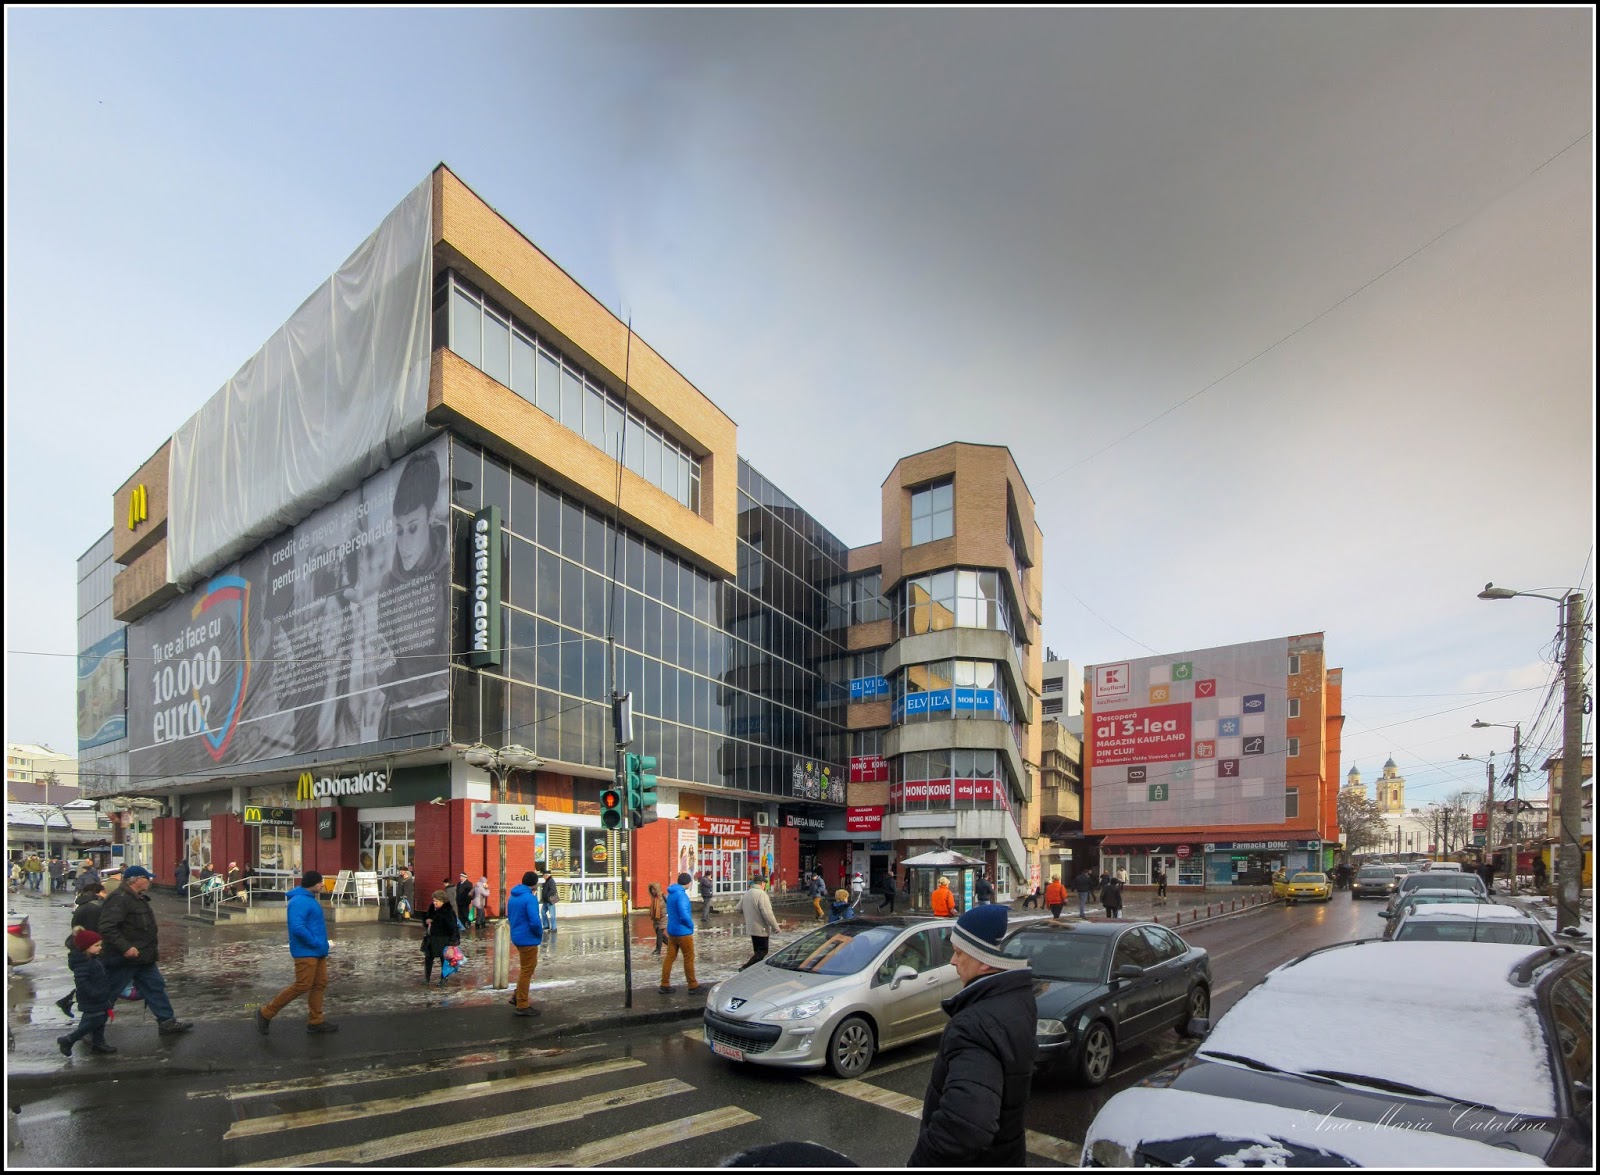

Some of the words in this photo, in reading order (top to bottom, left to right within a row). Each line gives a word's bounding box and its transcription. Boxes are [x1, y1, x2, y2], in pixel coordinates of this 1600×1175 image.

[273, 539, 296, 565] credit
[299, 533, 309, 551] de
[312, 514, 338, 543] nevoi
[342, 487, 396, 528] personale
[273, 568, 300, 595] pentru
[303, 544, 336, 580] planuri
[339, 519, 393, 562] personale
[474, 518, 488, 650] McDonald's
[152, 644, 162, 664] Tu
[164, 642, 174, 658] ce
[176, 630, 184, 654] ai
[186, 626, 206, 649] face
[208, 618, 221, 638] cu
[152, 646, 221, 705] 10.000
[153, 695, 211, 743] euro?
[1097, 712, 1138, 722] Descoperă
[1097, 722, 1115, 738] al
[1122, 718, 1177, 736] 3-lea
[1097, 738, 1135, 747] MAGAZIN
[1137, 734, 1185, 744] KAUFLAND
[297, 772, 386, 801] McDonald's
[906, 786, 927, 796] HONG
[929, 785, 950, 795] KONG
[959, 786, 982, 794] etajul
[710, 823, 735, 834] MIMI
[794, 817, 808, 826] MEGA
[809, 819, 824, 828] IMAGE
[724, 839, 739, 847] MIMI
